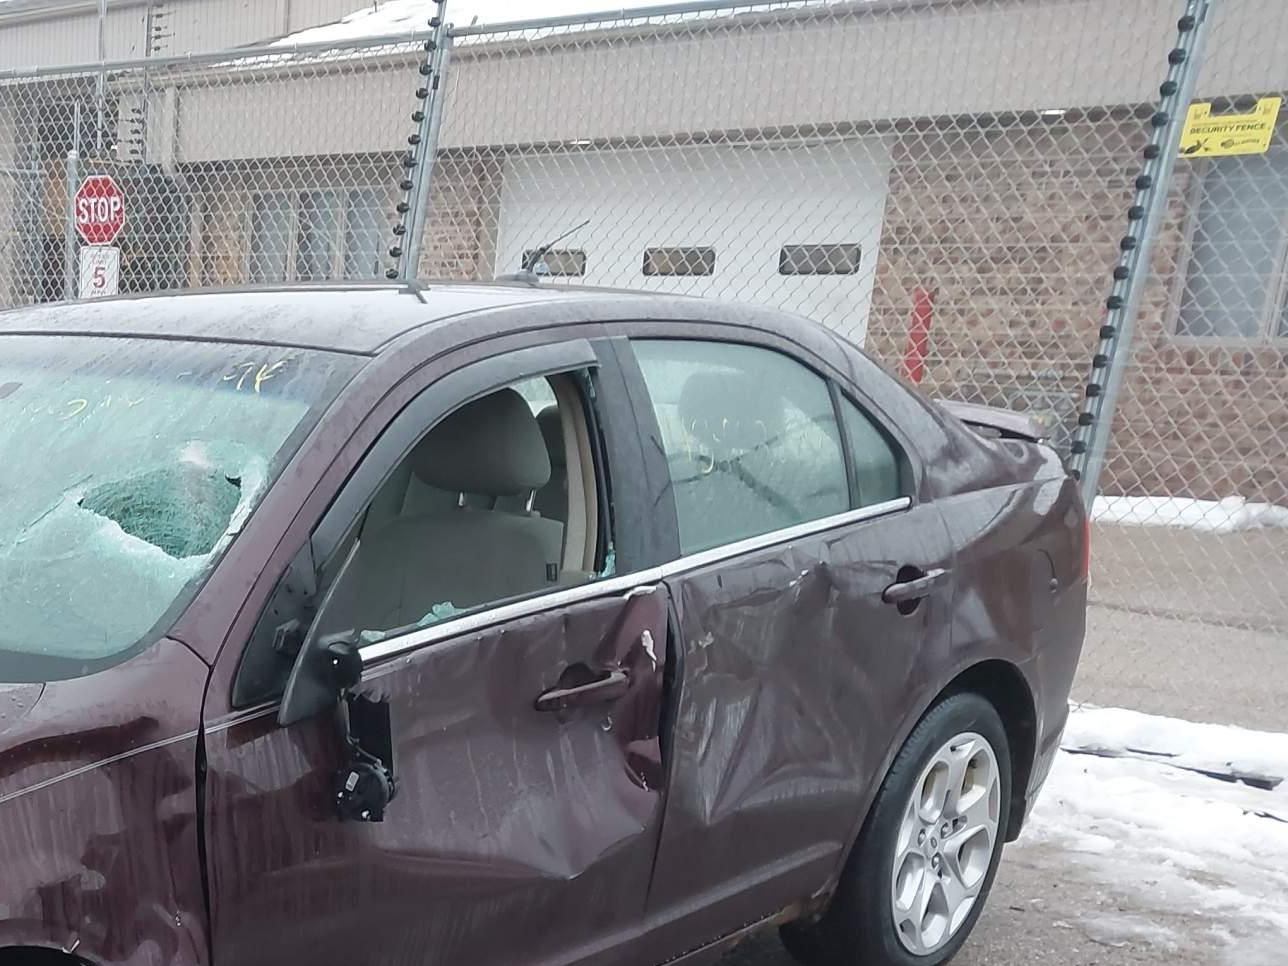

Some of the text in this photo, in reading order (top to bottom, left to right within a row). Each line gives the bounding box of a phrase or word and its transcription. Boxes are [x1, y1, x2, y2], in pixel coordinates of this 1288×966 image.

[1189, 126, 1234, 135] SECURITY
[1235, 123, 1266, 131] FENCE
[79, 197, 121, 223] STOP
[93, 266, 105, 288] 5
